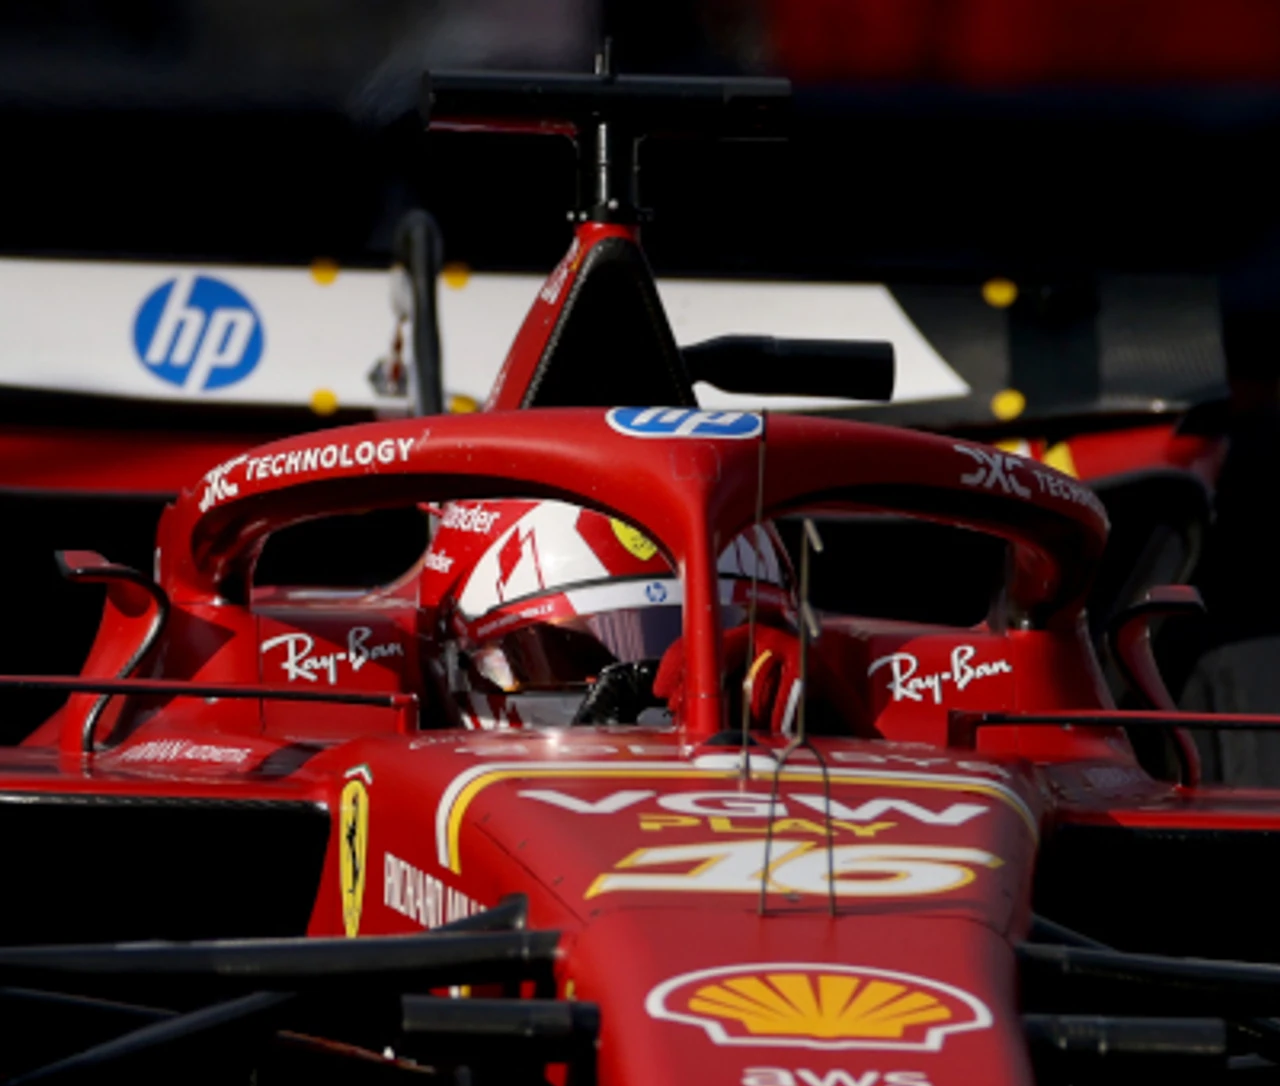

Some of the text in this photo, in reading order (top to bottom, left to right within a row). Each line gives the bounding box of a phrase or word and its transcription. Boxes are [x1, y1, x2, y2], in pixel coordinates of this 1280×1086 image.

[144, 274, 256, 393] hp
[245, 437, 415, 480] TECHNOLOGY
[260, 627, 404, 684] Ray-Ban
[868, 645, 1011, 704] Ray-Ban
[519, 789, 989, 826] VGW
[639, 813, 899, 837] PLAY
[585, 840, 1004, 898] 16
